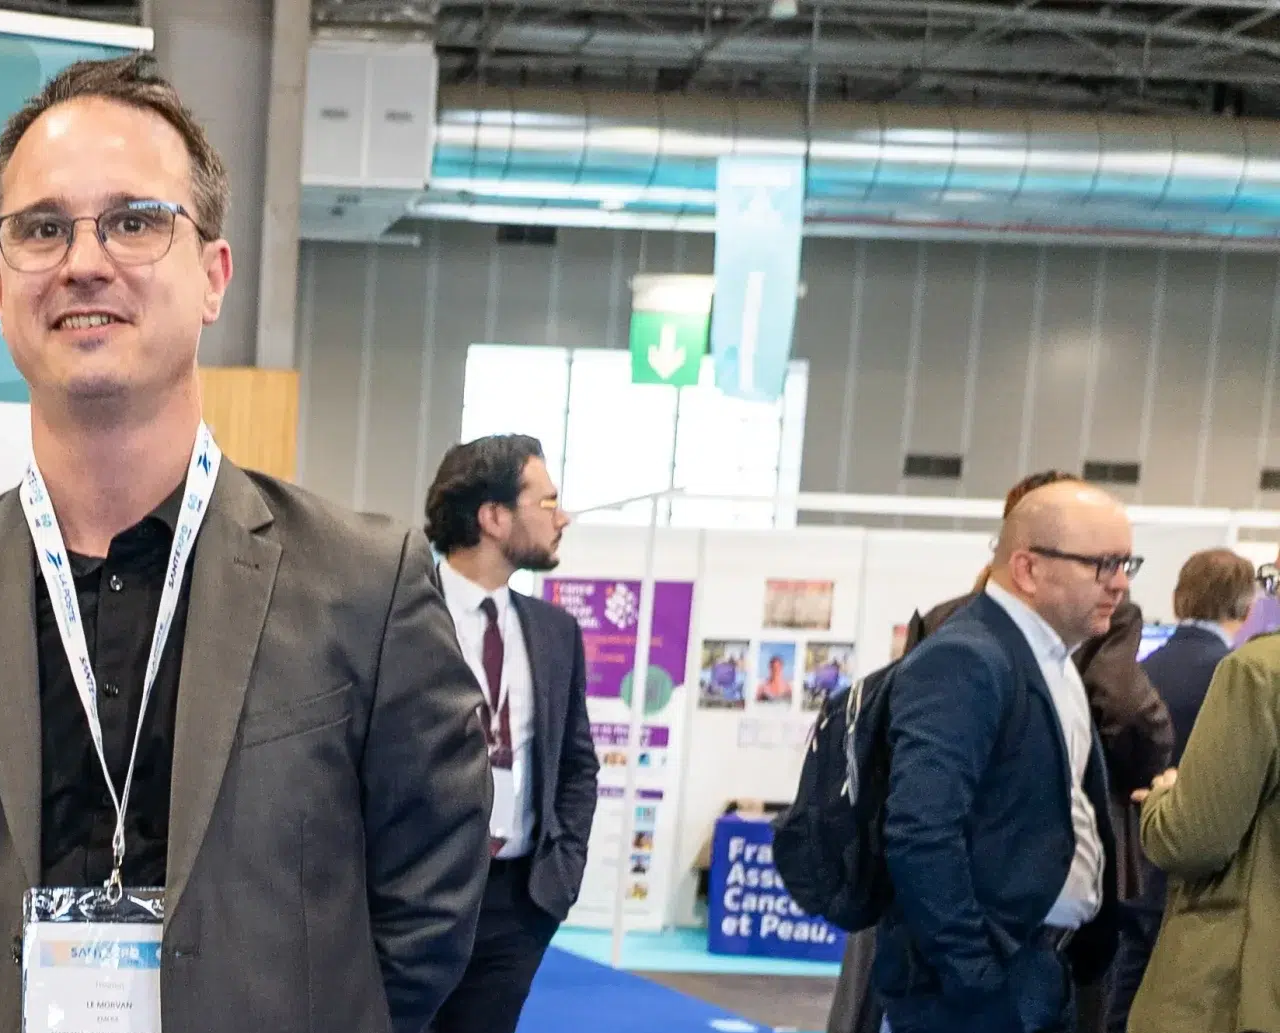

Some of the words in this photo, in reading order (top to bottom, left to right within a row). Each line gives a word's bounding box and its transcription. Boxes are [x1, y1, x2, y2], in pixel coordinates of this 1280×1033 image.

[728, 835, 774, 865] Fra
[721, 913, 752, 937] et
[760, 913, 837, 944] Peau.
